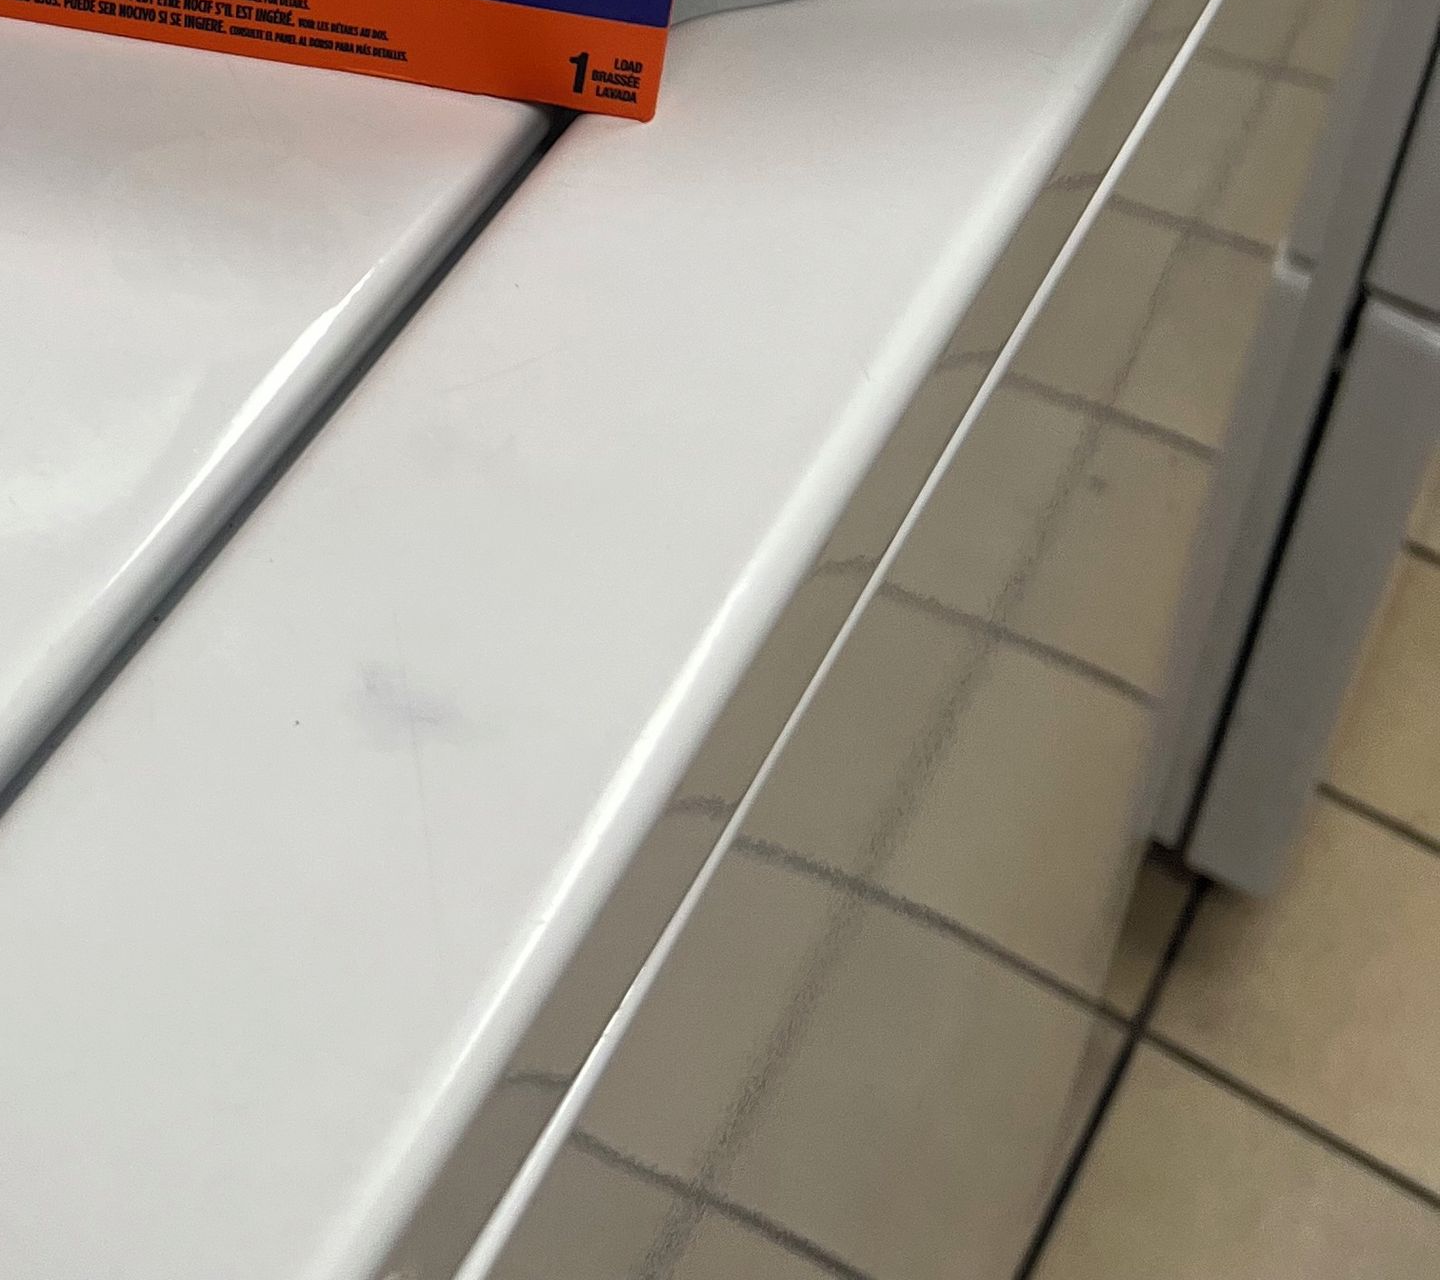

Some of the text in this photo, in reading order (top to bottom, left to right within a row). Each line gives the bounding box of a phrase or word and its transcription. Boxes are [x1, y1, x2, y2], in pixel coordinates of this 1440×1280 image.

[98, 0, 116, 15] SER
[118, 4, 156, 21] NOCIVO
[170, 12, 181, 26] SE
[184, 14, 225, 33] INGIERE.
[235, 4, 252, 19] EST
[255, 8, 293, 26] INGÉRÉ.
[569, 51, 589, 94] 1
[613, 57, 643, 73] LOAD
[591, 69, 642, 89] BRASSÉE
[595, 85, 638, 103] LAVADA
